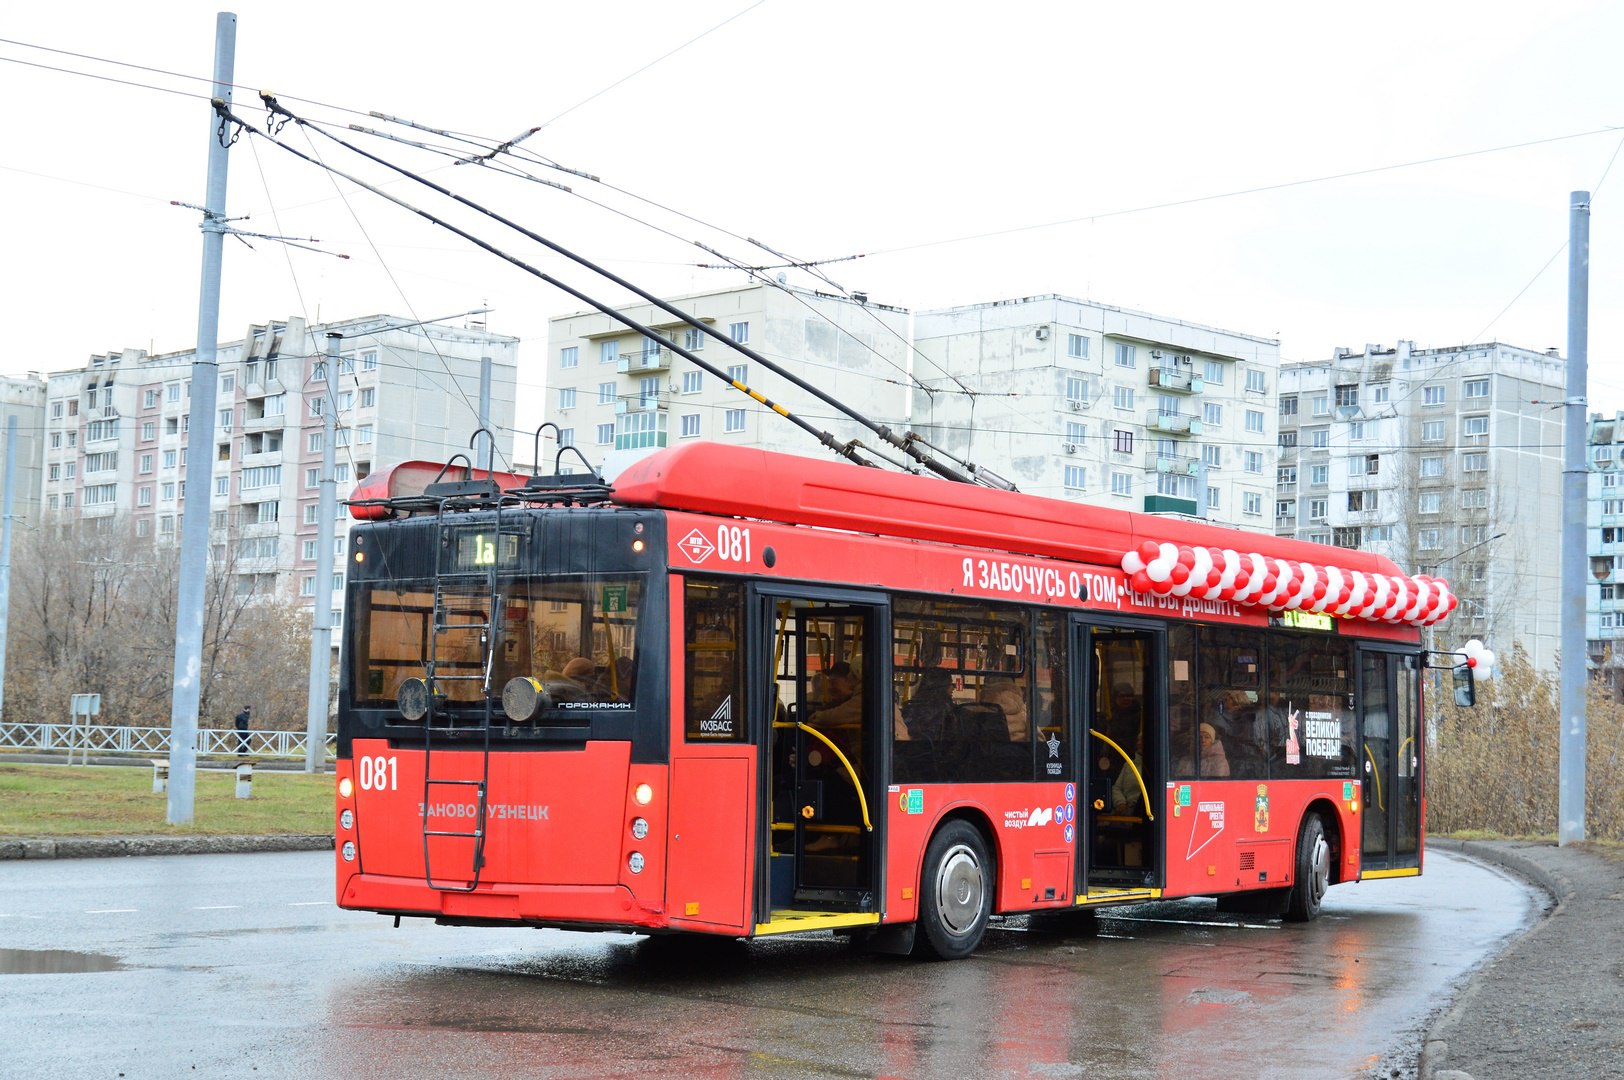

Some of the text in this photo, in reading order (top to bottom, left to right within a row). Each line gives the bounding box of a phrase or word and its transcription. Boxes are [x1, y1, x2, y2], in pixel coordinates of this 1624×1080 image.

[717, 524, 751, 563] 081
[962, 557, 974, 587] Я
[978, 559, 1066, 598] ЗАБОЧУСЬ
[1069, 571, 1081, 599] О
[700, 720, 733, 732] КУЗБАСС
[1305, 718, 1341, 738] ВЕЛИКОЙ
[1305, 739, 1341, 759] ПОБЕДЫ!
[359, 756, 398, 791] 081
